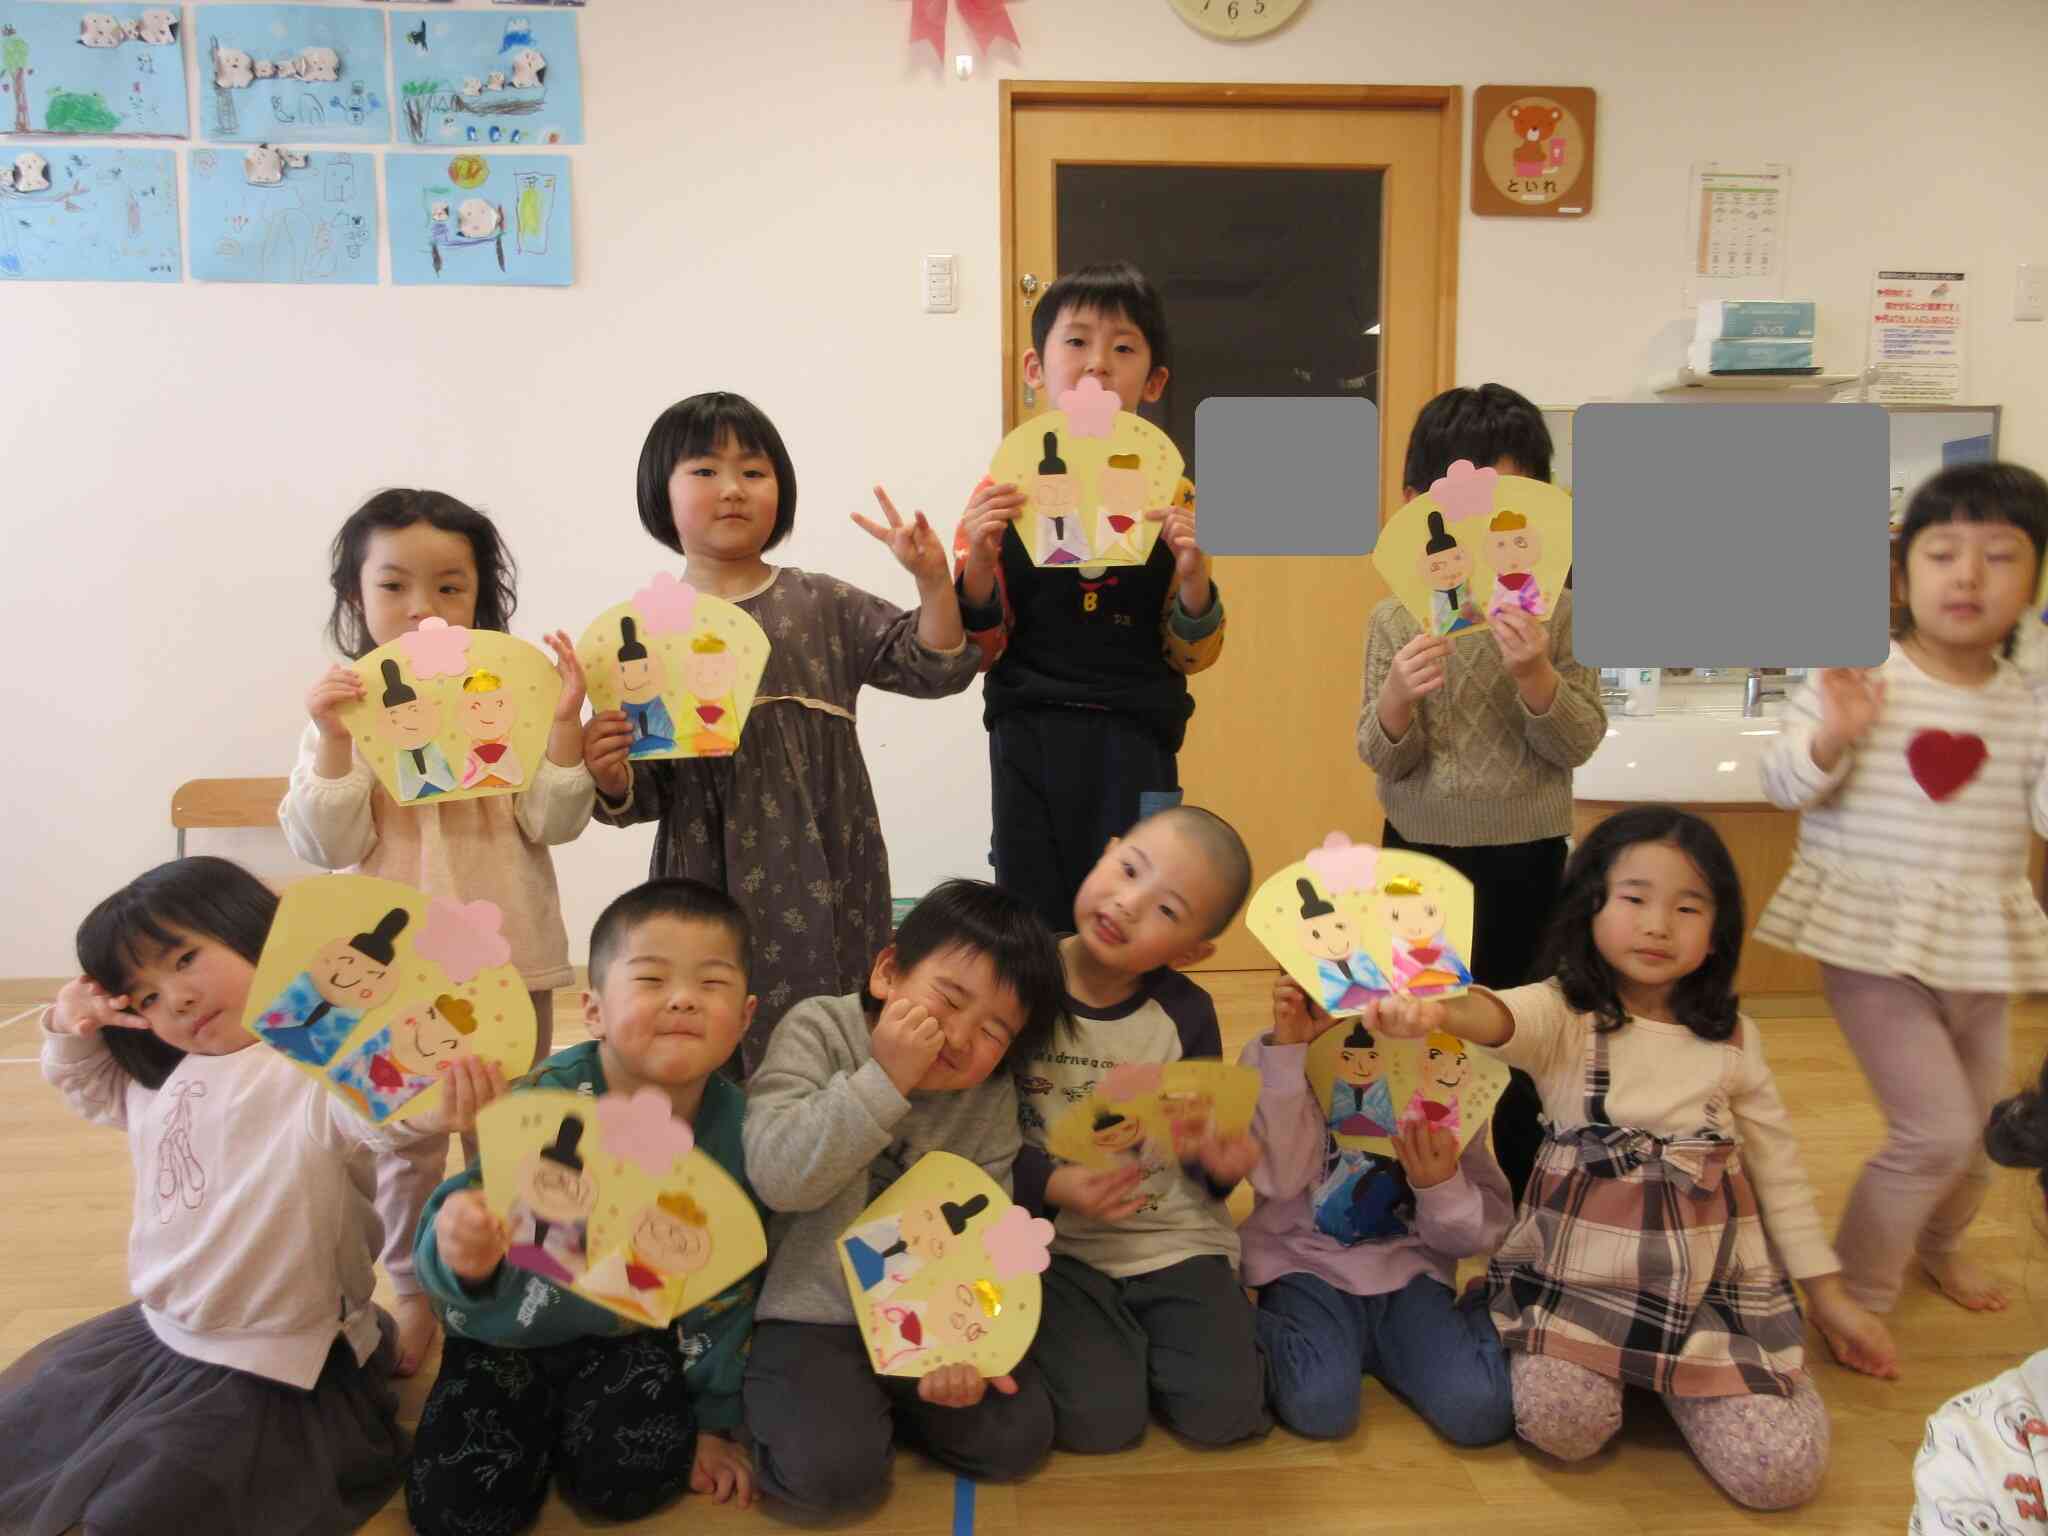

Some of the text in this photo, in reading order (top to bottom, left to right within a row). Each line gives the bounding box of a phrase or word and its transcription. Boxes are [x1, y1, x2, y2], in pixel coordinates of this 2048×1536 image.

[1227, 1, 1239, 20] 6
[1507, 179, 1556, 193] といれ
